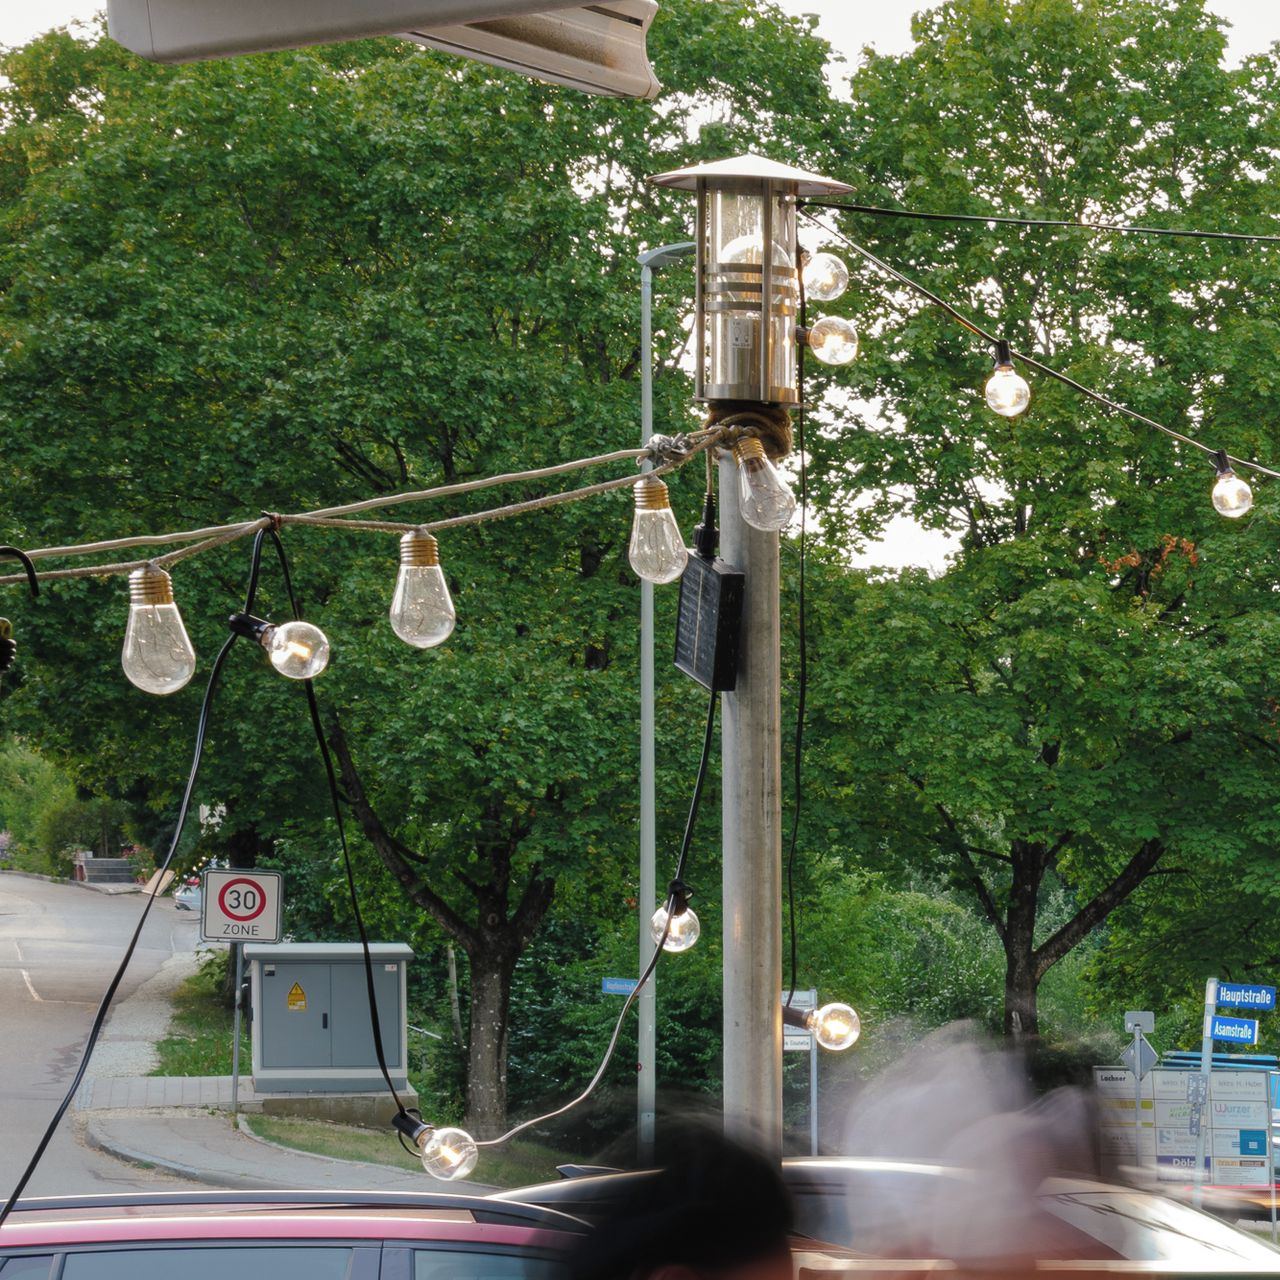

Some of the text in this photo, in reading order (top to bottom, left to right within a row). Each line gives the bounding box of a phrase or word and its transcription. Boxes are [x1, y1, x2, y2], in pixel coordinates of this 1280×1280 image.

[228, 889, 256, 910] 30
[223, 923, 260, 936] ZONE
[1220, 986, 1272, 1006] Hauptstraße
[1214, 1021, 1252, 1039] Asamstraße
[1173, 1158, 1196, 1168] Dölz
